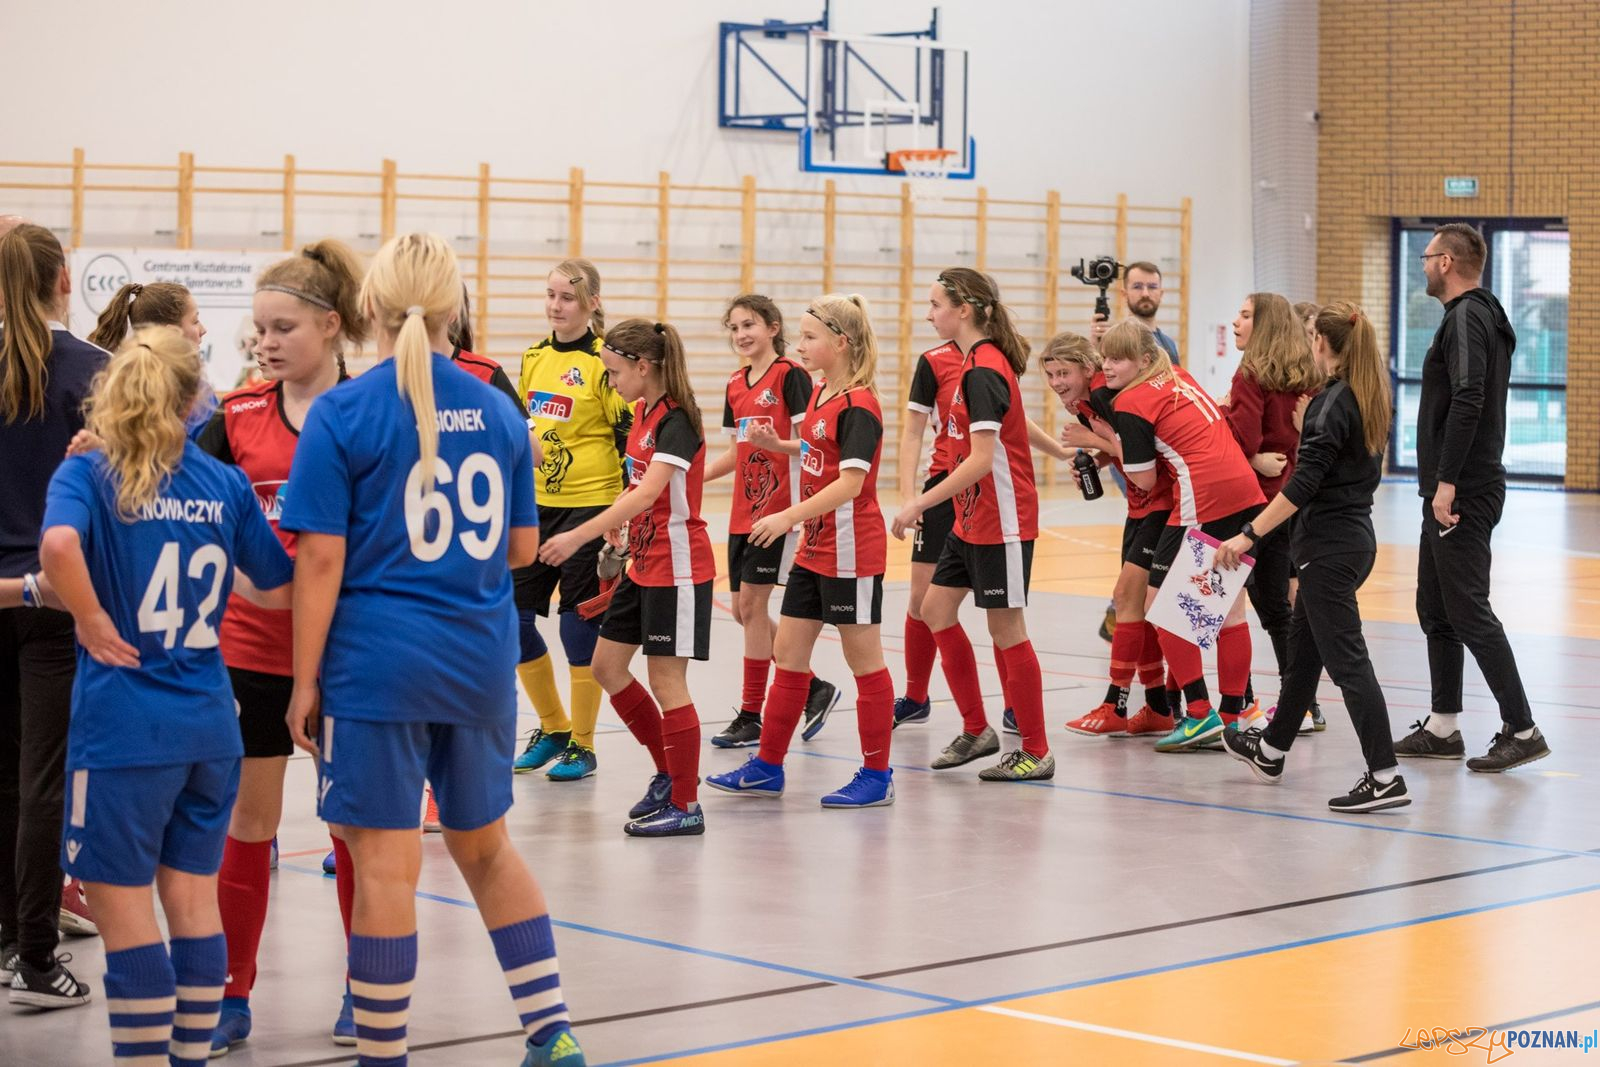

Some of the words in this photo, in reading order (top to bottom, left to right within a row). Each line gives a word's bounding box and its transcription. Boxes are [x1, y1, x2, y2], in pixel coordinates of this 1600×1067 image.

[143, 497, 225, 524] NOWACZYK
[404, 452, 505, 562] 69
[137, 541, 228, 650] 42
